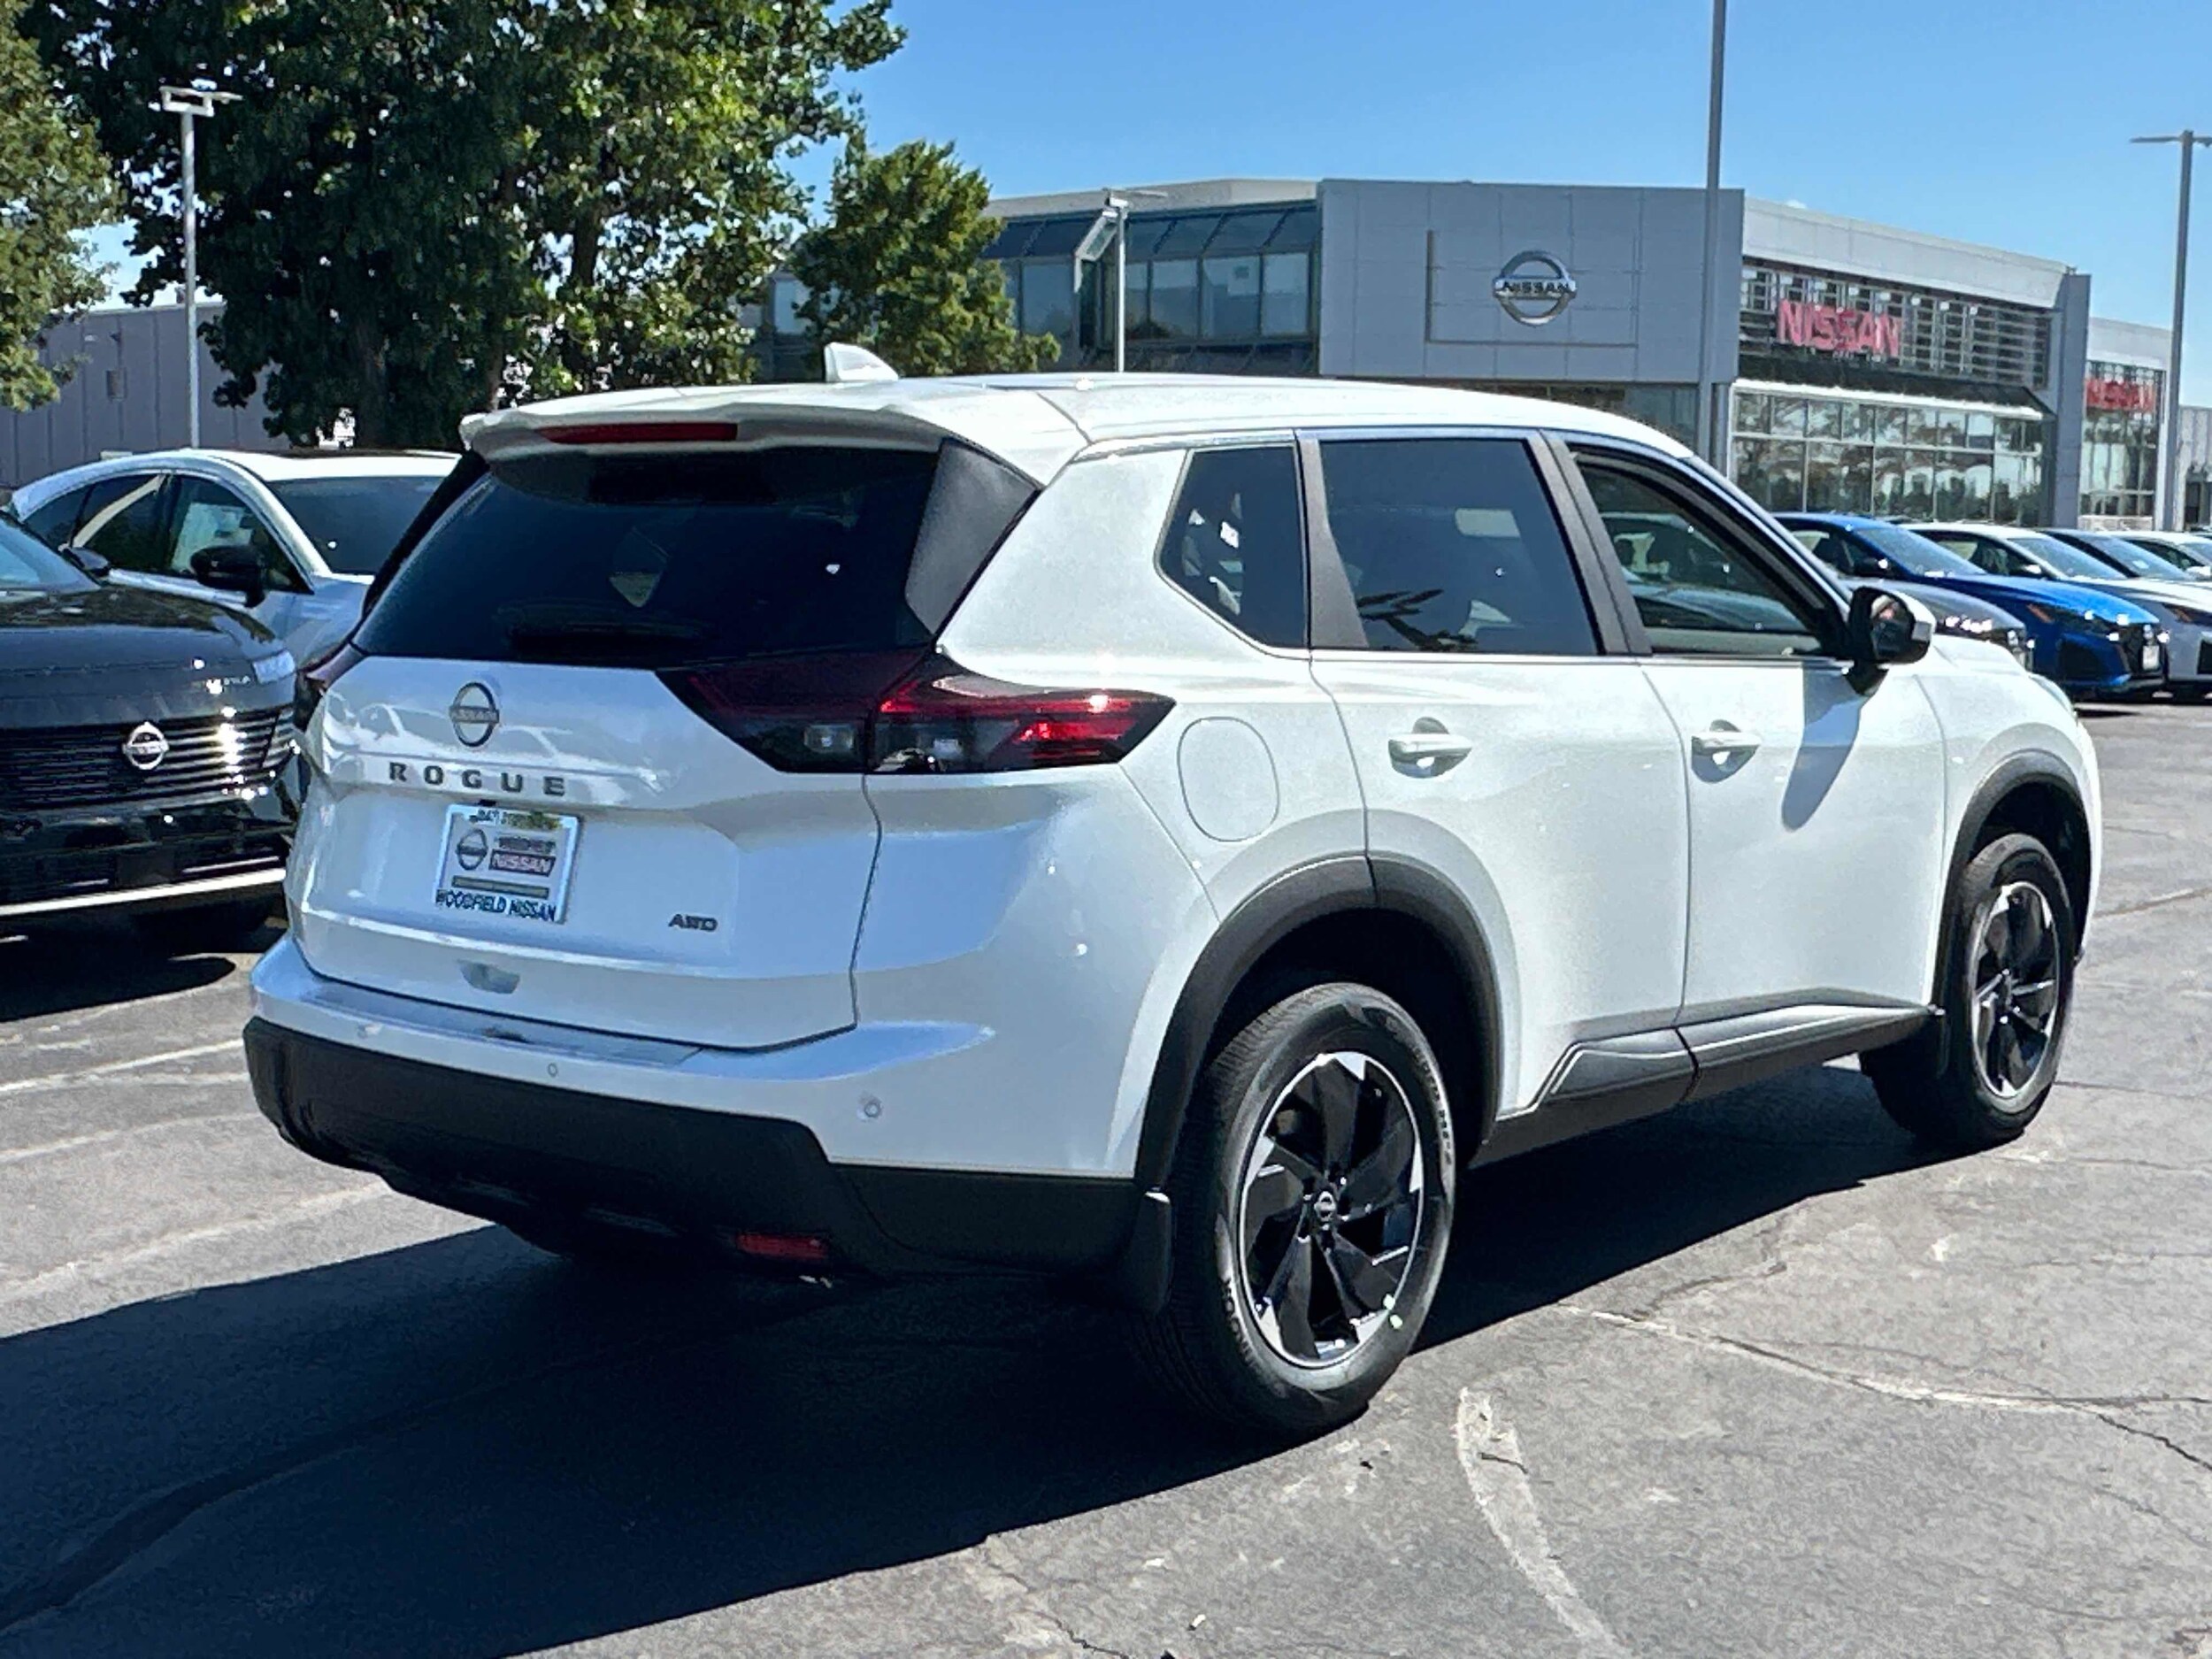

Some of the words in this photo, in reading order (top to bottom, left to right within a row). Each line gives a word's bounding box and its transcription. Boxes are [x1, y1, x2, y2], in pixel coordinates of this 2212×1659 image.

[1499, 281, 1571, 294] NISSAN
[1778, 297, 1900, 357] NISSAN
[2085, 378, 2155, 413] NISSAN
[389, 762, 565, 796] ROGUE
[492, 853, 550, 874] NISSAN
[508, 897, 557, 922] NISSAN
[668, 914, 718, 932] AWD
